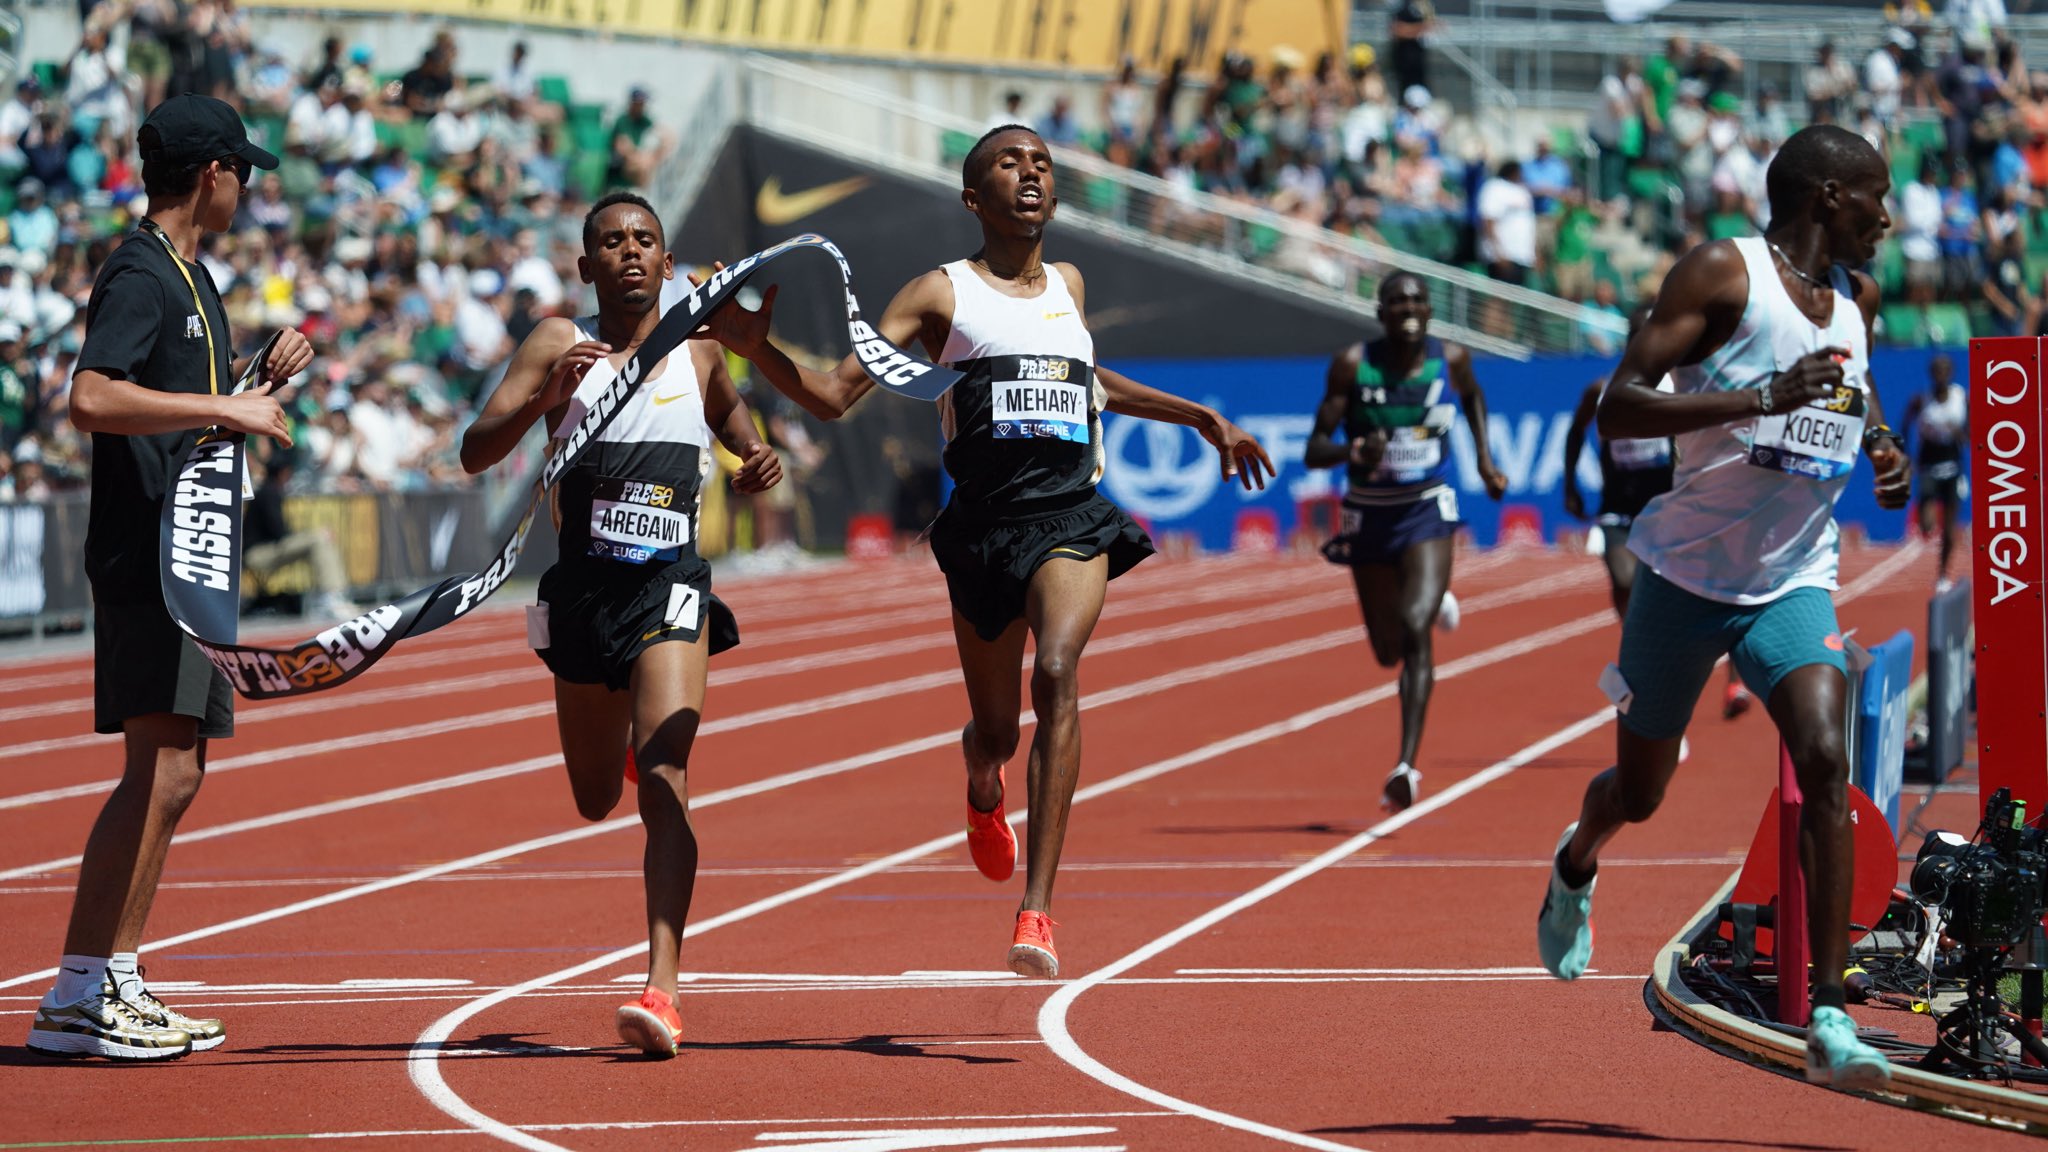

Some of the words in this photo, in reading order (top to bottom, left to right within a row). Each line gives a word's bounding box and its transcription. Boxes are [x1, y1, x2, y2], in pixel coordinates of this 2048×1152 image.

[1017, 359, 1070, 380] PRE50
[1006, 388, 1077, 415] MEHARY
[1020, 423, 1070, 436] EUGENE
[1782, 413, 1847, 451] KOECH
[1780, 455, 1834, 478] EUGENE
[620, 481, 674, 508] PRE50
[172, 441, 234, 591] CLASSIC
[600, 508, 680, 544] AREGAWI
[1987, 421, 2029, 606] OMEGA
[612, 545, 651, 561] EUGEN
